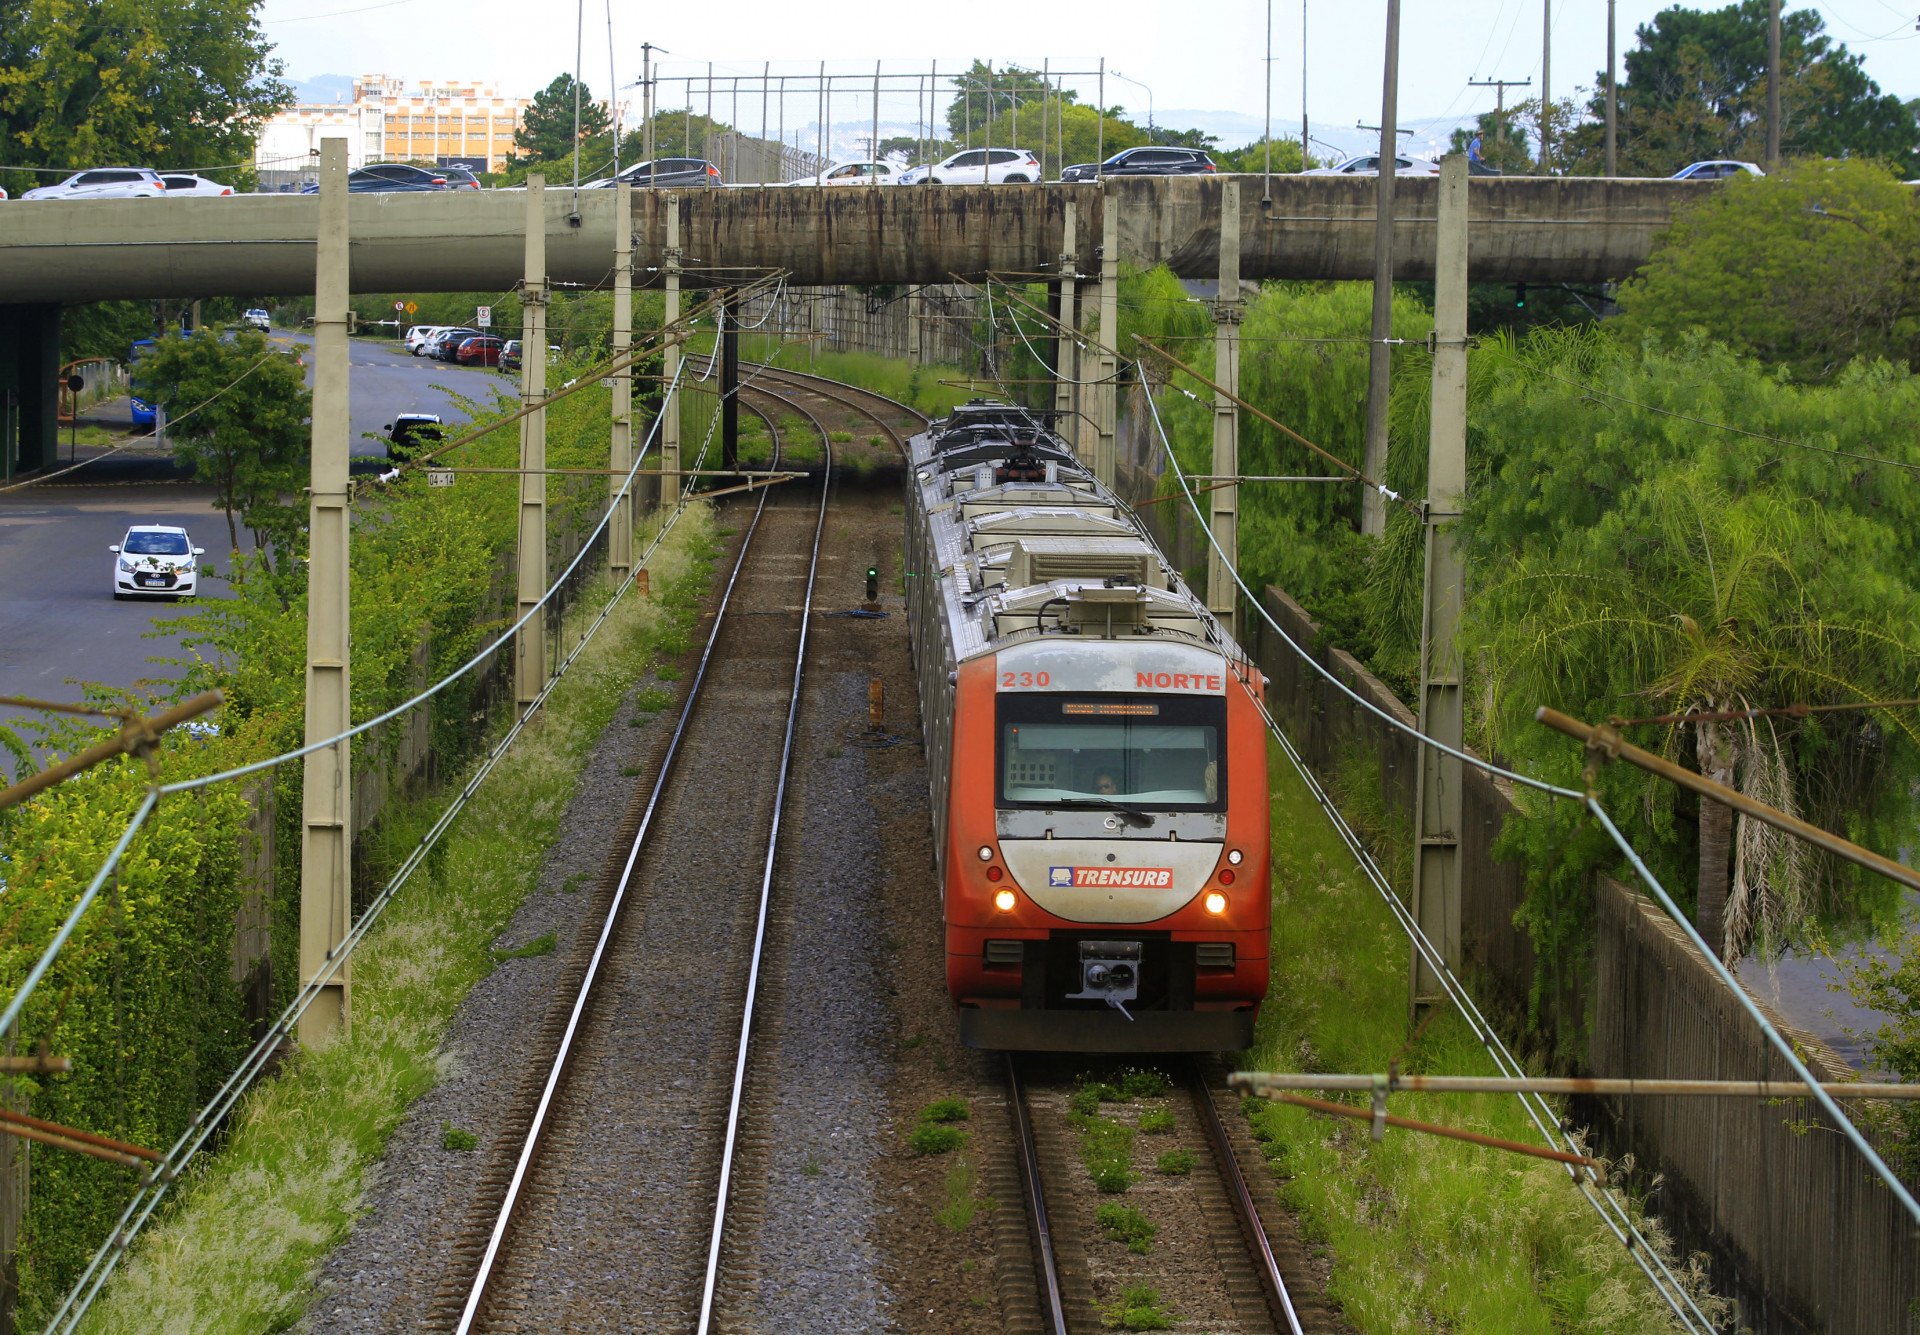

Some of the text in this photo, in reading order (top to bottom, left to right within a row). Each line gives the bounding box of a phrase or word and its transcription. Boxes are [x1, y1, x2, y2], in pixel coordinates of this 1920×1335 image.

[1002, 671, 1050, 687] 230
[1136, 672, 1221, 691] NORTE
[1075, 869, 1170, 886] TRENSURB
